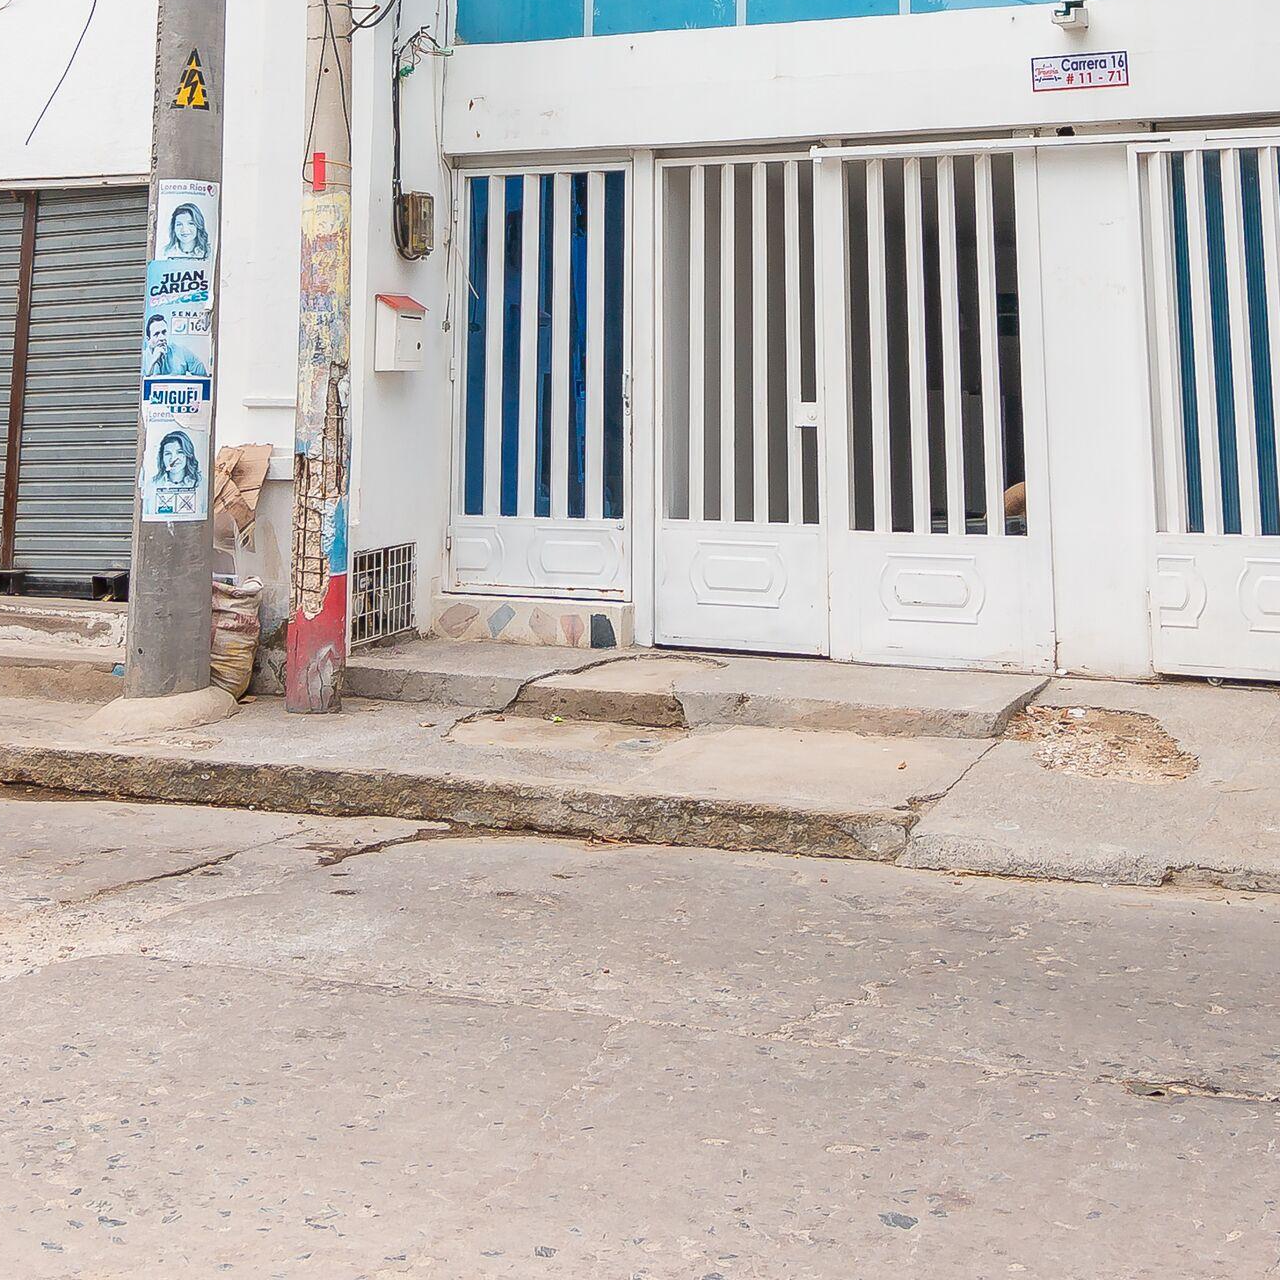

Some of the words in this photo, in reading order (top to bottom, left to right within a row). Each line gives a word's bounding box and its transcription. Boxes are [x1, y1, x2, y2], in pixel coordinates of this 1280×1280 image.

[1061, 58, 1108, 72] Carrera
[1111, 54, 1124, 68] 16
[1066, 73, 1074, 84] #
[1079, 71, 1092, 83] 11
[1107, 70, 1122, 81] 71
[160, 183, 188, 191] Lorena
[160, 270, 205, 285] JUAN
[150, 280, 209, 297] CARLOS
